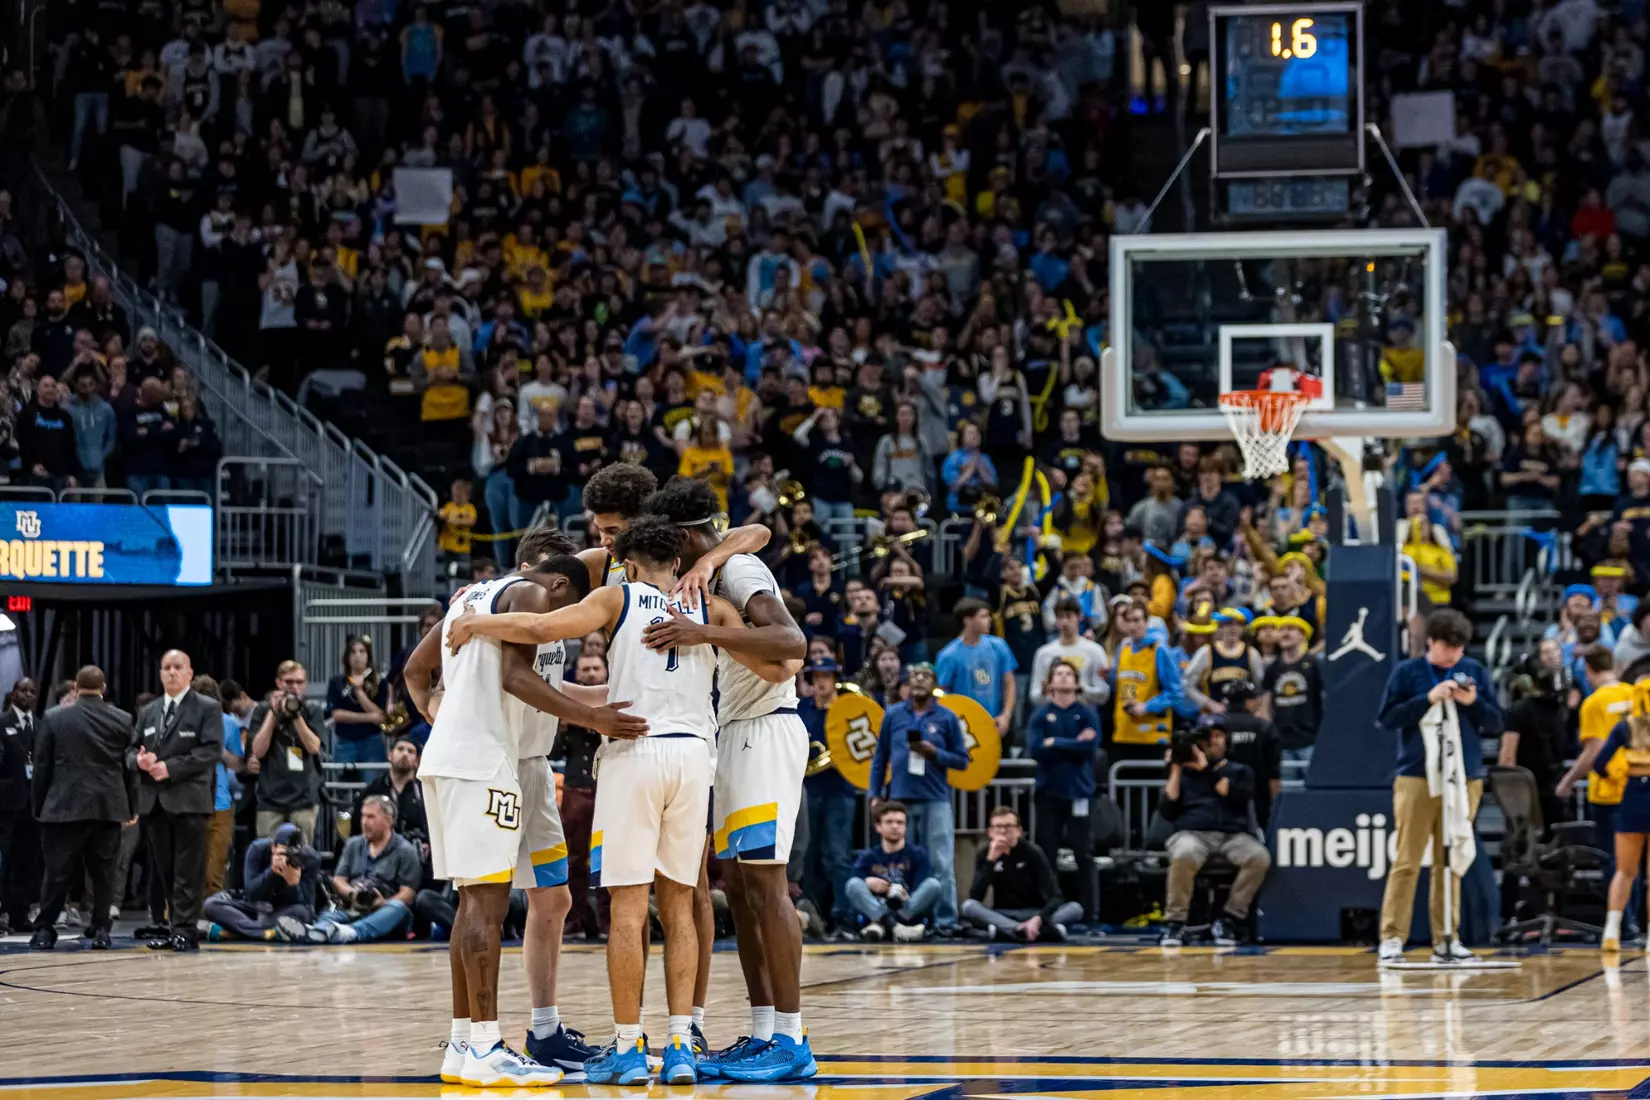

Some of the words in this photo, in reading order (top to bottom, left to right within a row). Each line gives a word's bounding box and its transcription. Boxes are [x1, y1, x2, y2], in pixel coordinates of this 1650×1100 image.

[1271, 18, 1317, 59] 1.6
[16, 510, 41, 538] MU
[485, 787, 521, 831] MU
[1276, 813, 1434, 880] meij
